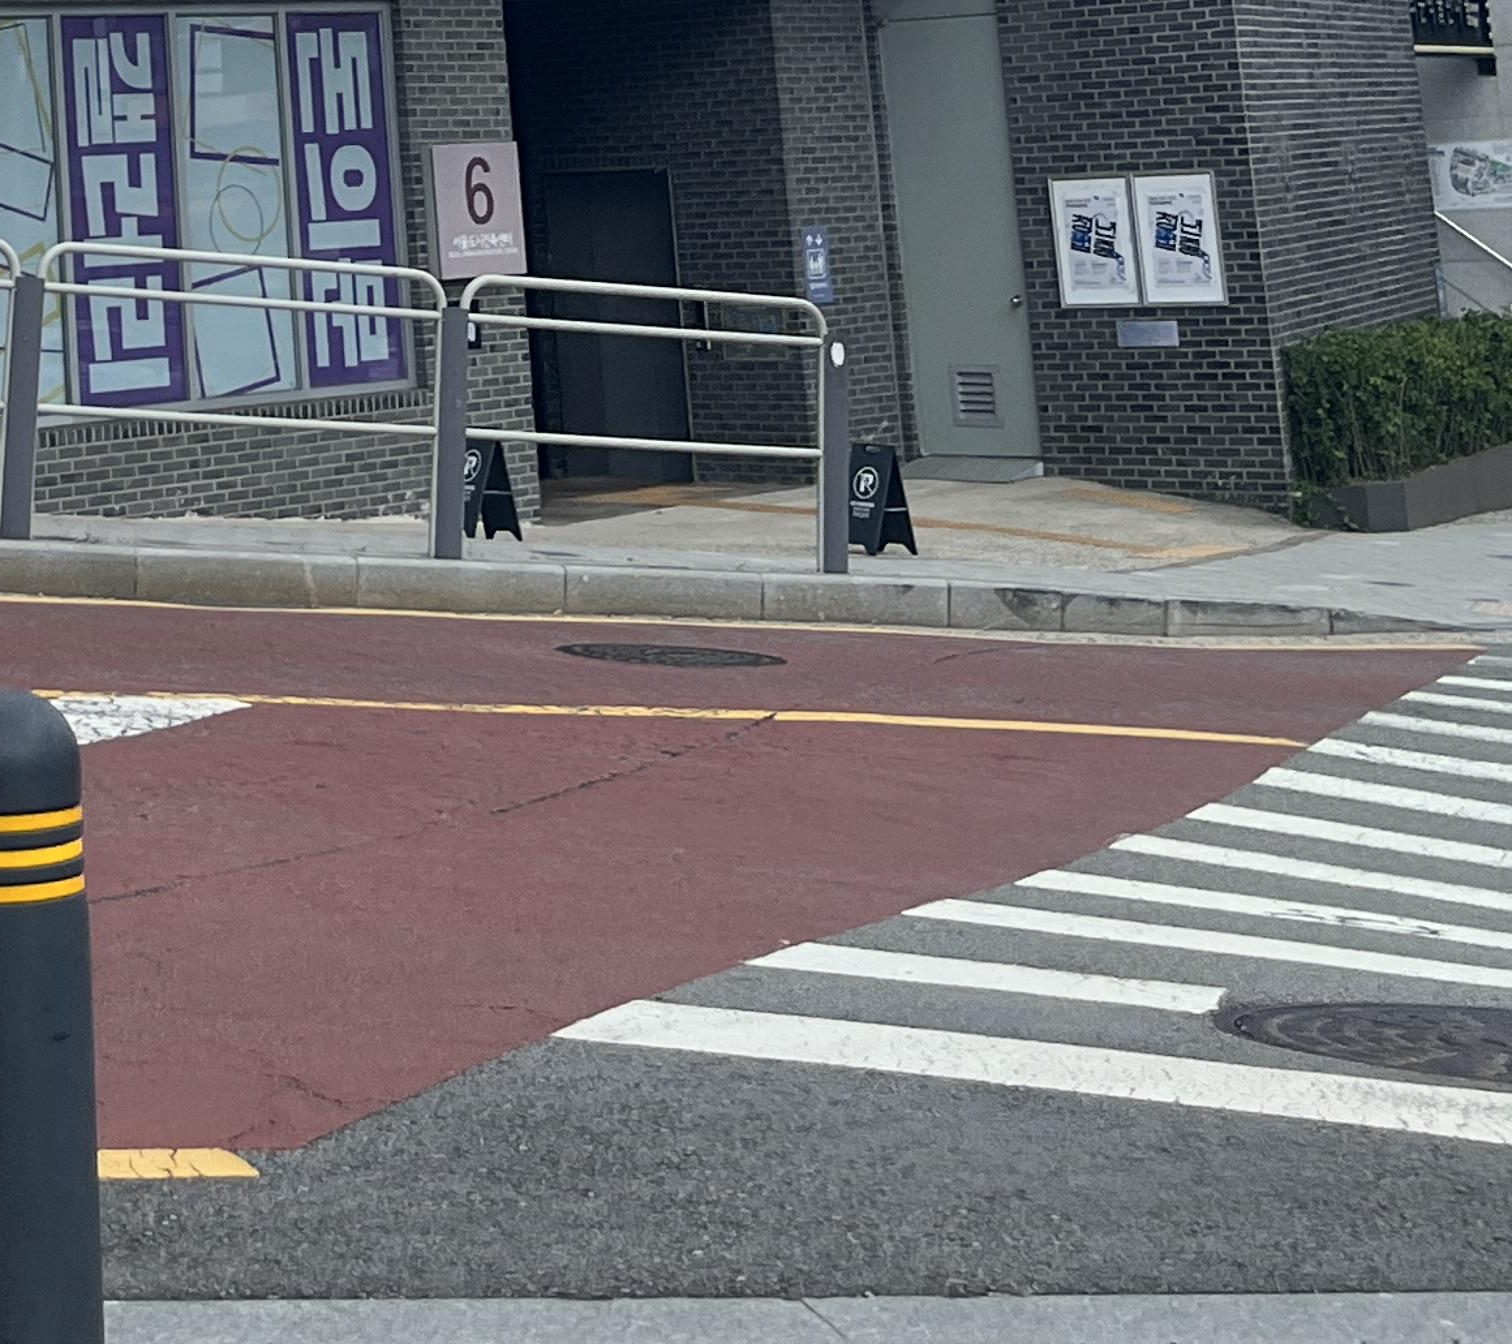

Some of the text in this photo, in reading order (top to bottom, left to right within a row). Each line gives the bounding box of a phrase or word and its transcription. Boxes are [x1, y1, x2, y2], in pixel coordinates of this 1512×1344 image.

[71, 31, 172, 395] 갤러리
[294, 27, 390, 369] 돈의문
[465, 156, 495, 225] 6
